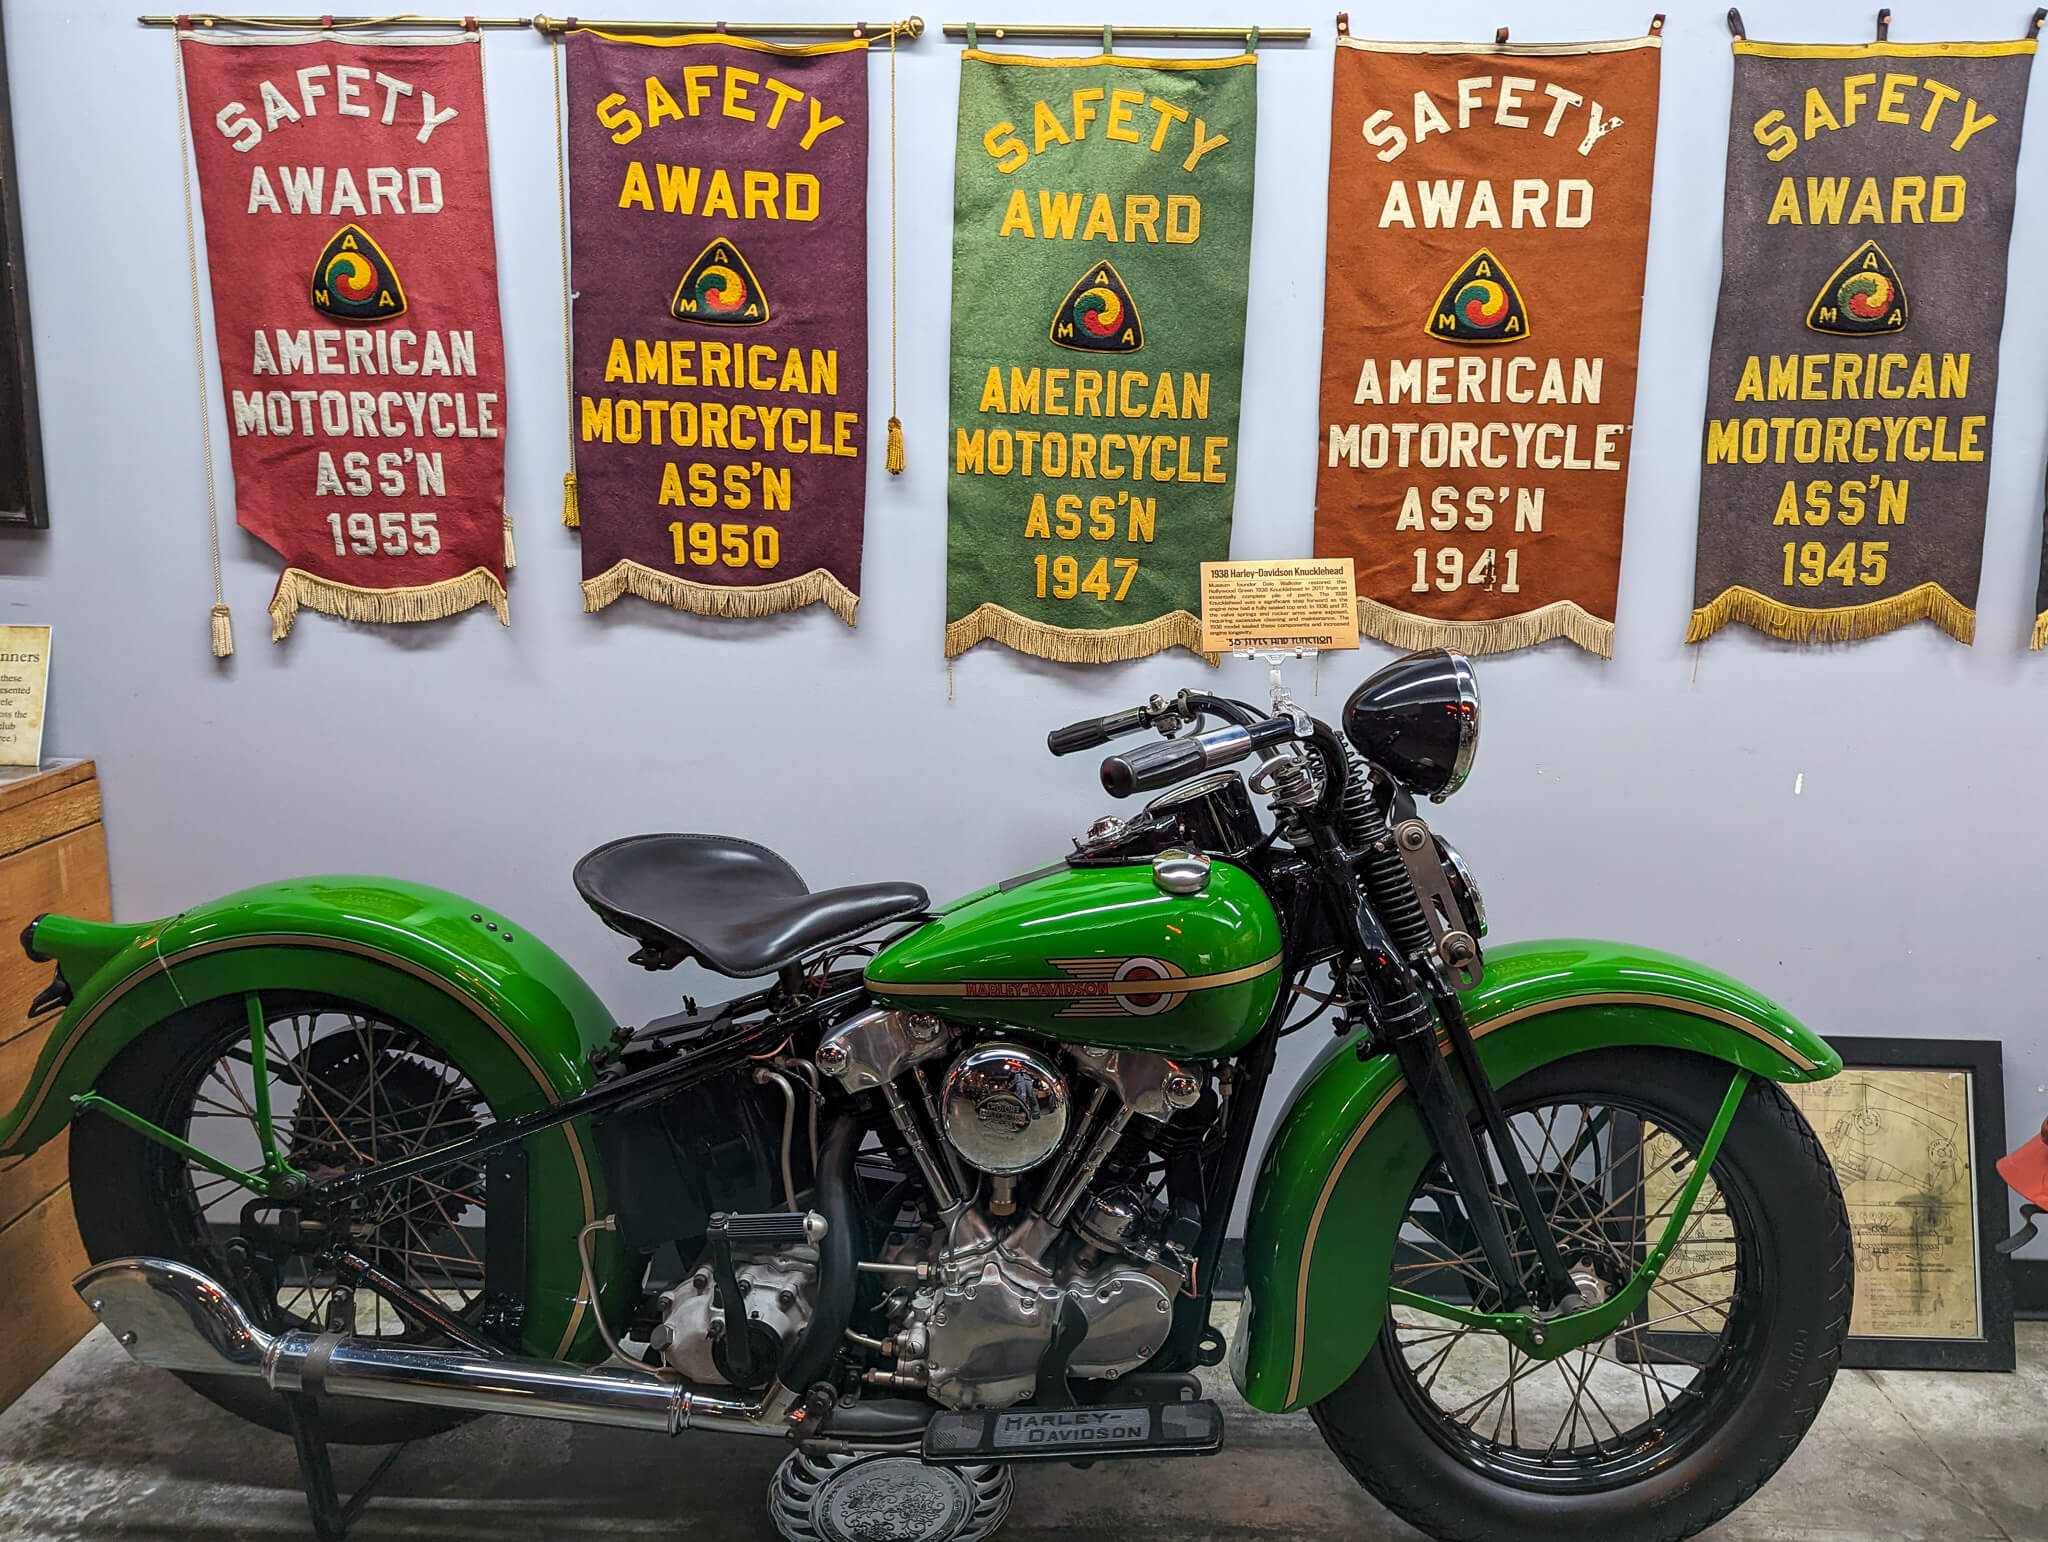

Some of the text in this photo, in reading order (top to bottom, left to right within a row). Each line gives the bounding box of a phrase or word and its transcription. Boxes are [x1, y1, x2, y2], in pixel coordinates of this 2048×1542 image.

[216, 65, 459, 152] SAFETY
[596, 65, 845, 151] SAFETY
[983, 88, 1229, 174] SAFETY
[1361, 76, 1625, 163] SAFETY
[1752, 72, 1999, 162] SAFETY
[248, 166, 444, 216] AWARD
[618, 161, 820, 222] AWARD
[1377, 178, 1594, 229] AWARD
[1766, 175, 1967, 225] AWARD
[999, 189, 1202, 244] AWARD
[253, 329, 477, 377] AMERICAN
[604, 338, 838, 395] AMERICAN
[1734, 353, 1972, 402] AMERICAN
[979, 366, 1211, 419] AMERICAN
[1353, 356, 1604, 405] AMERICAN
[231, 390, 498, 438] MOTORCYCLE
[580, 396, 858, 457] MOTORCYCLE
[956, 427, 1229, 484] MOTORCYCLE
[1327, 422, 1625, 471] MOTORCYCLE
[1706, 415, 1987, 465] MOTORCYCLE
[316, 447, 446, 497] ASS'N
[658, 462, 791, 511] ASS'N
[1024, 491, 1157, 543] ASS'N
[1395, 486, 1545, 533] ASS'N
[1772, 474, 1909, 526] ASS'N
[326, 512, 441, 557] 1955
[668, 522, 780, 569] 1950
[1033, 555, 1140, 601] 1947
[1211, 565, 1344, 579] 1938 Harley-Davidson Knucklehead
[1411, 547, 1520, 594] 1941
[1782, 541, 1891, 587] 1945
[0, 674, 22, 682] these
[14, 710, 28, 719] the
[966, 982, 1109, 996] HARLEY-DAVIDSON
[1004, 1411, 1122, 1432] HARLEY-
[1028, 1426, 1142, 1443] DAVIDSON
